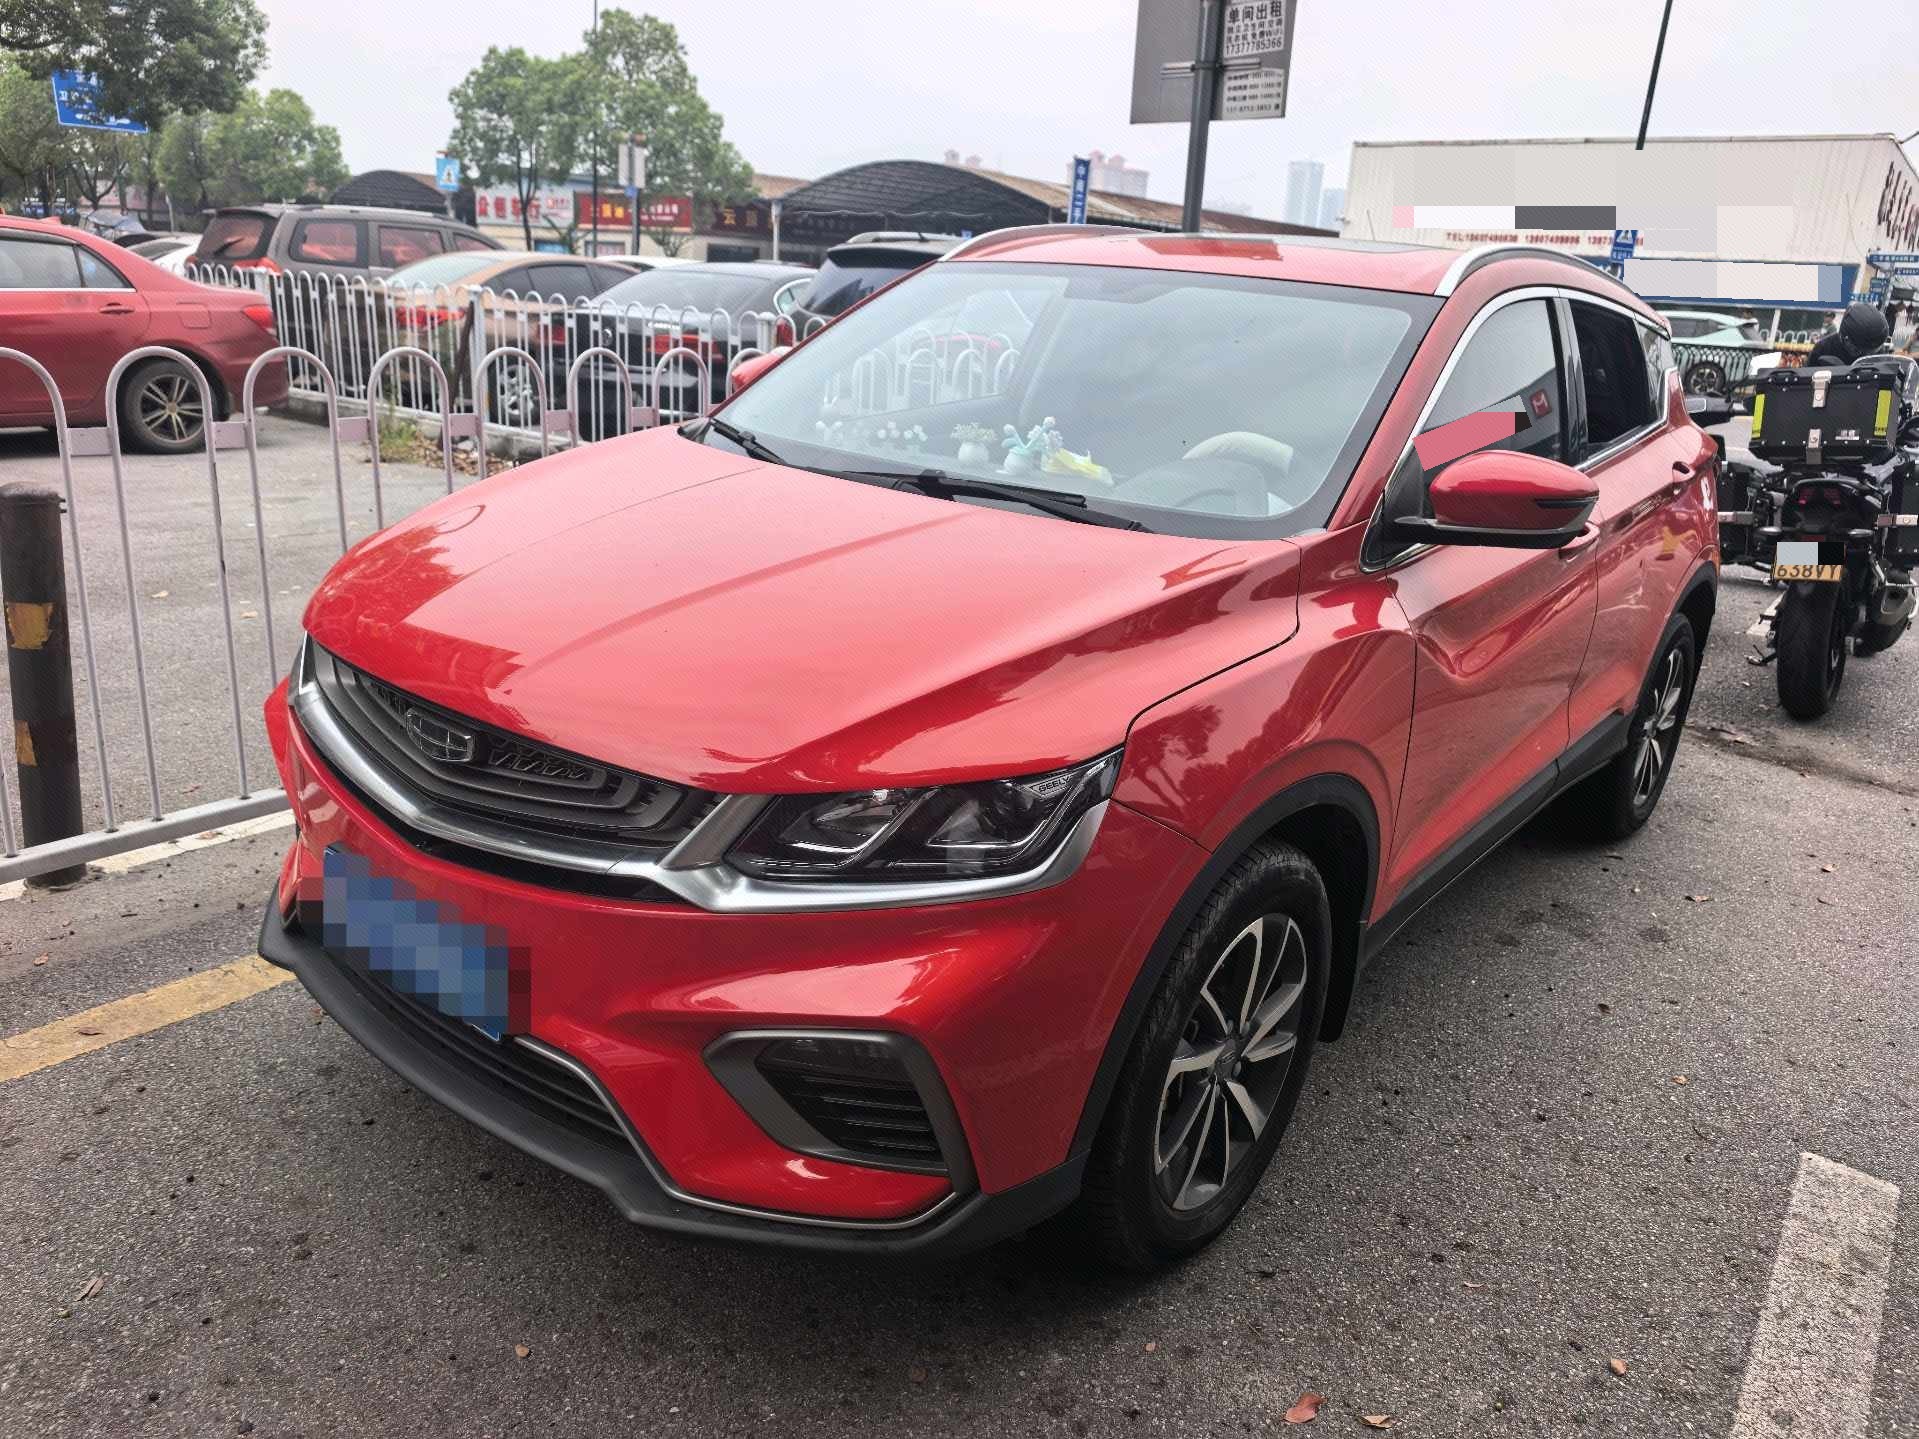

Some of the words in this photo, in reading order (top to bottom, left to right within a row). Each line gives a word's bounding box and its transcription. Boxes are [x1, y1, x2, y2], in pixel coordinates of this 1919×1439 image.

[1228, 1, 1282, 23] 单间出租
[1038, 776, 1072, 792] GEELY
